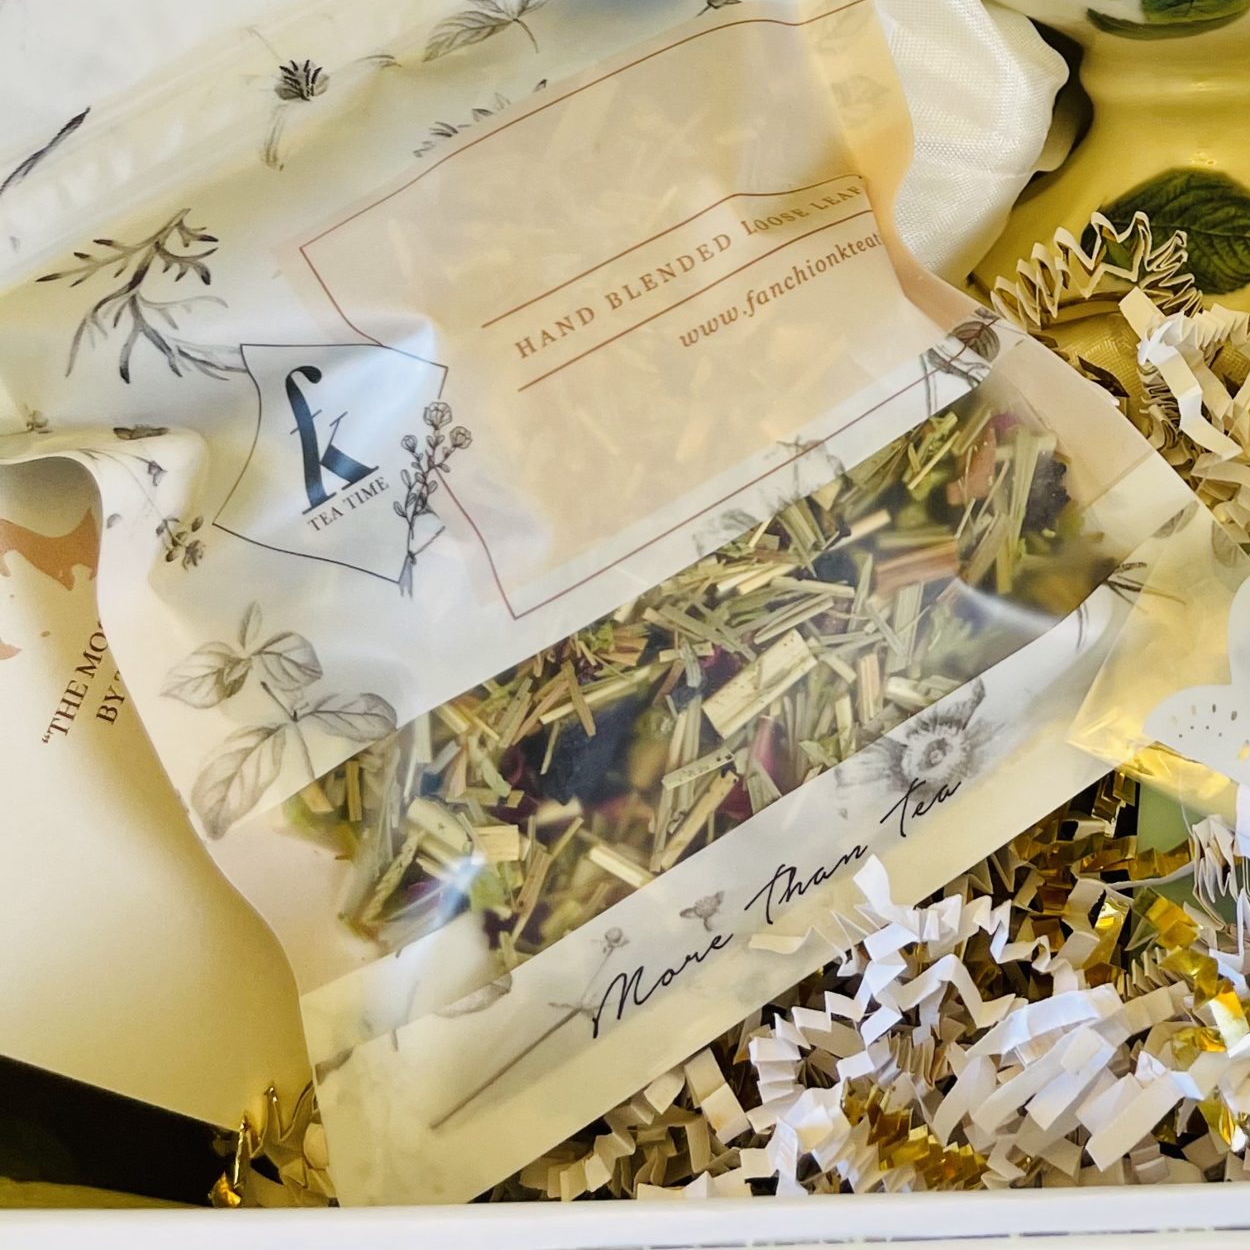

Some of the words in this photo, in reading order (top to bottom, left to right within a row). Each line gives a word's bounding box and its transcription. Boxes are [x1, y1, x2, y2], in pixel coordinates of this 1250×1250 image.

[514, 306, 596, 359] HAND
[605, 233, 732, 311] BLENDED
[741, 206, 810, 236] LOOSE
[810, 185, 862, 211] LEAF
[307, 507, 344, 533] TEA
[343, 476, 390, 512] TIME
[75, 621, 109, 679] MO
[96, 685, 125, 725] BY
[592, 933, 734, 1040] More
